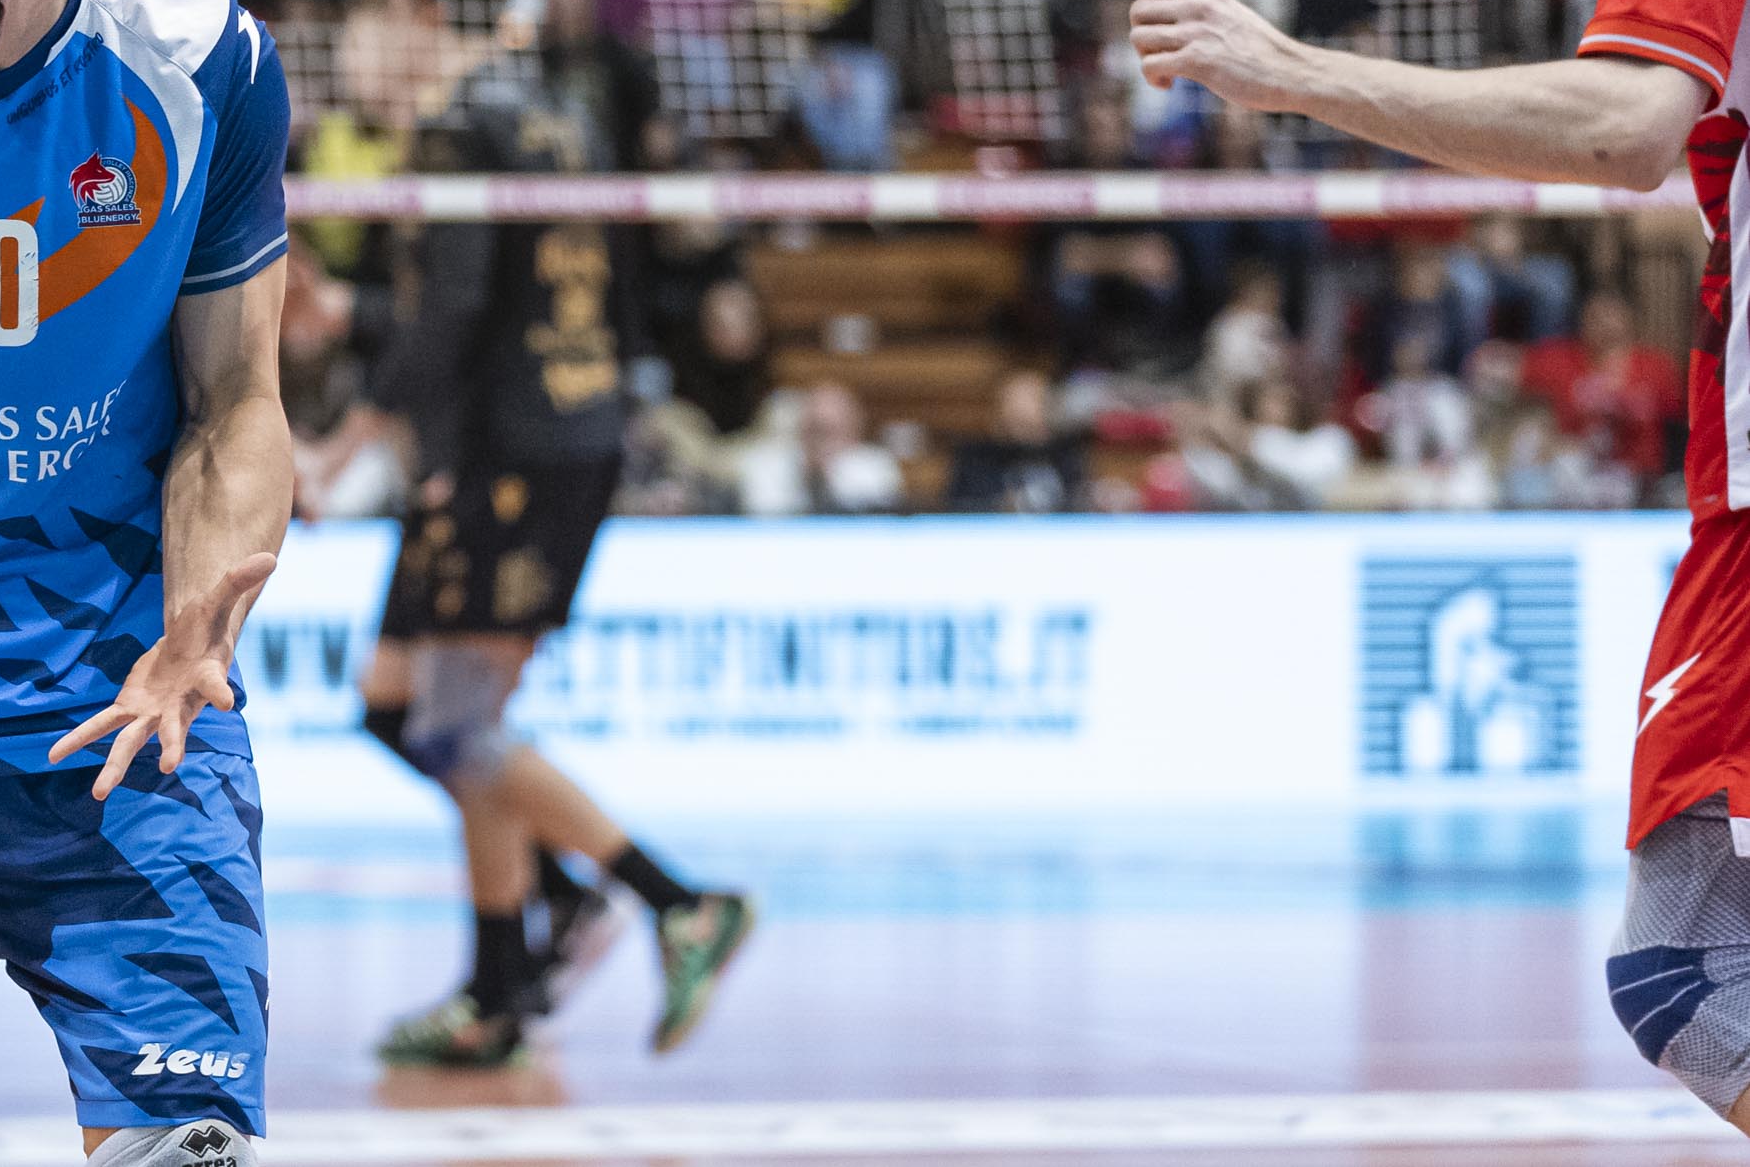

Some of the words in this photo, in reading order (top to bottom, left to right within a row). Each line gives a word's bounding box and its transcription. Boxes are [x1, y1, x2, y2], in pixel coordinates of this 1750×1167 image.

[59, 66, 73, 88] ET
[81, 213, 138, 224] BLUENERGY
[83, 205, 103, 213] GAS
[104, 203, 134, 212] SALES
[35, 379, 128, 441] SALE
[131, 1042, 250, 1079] Zeus
